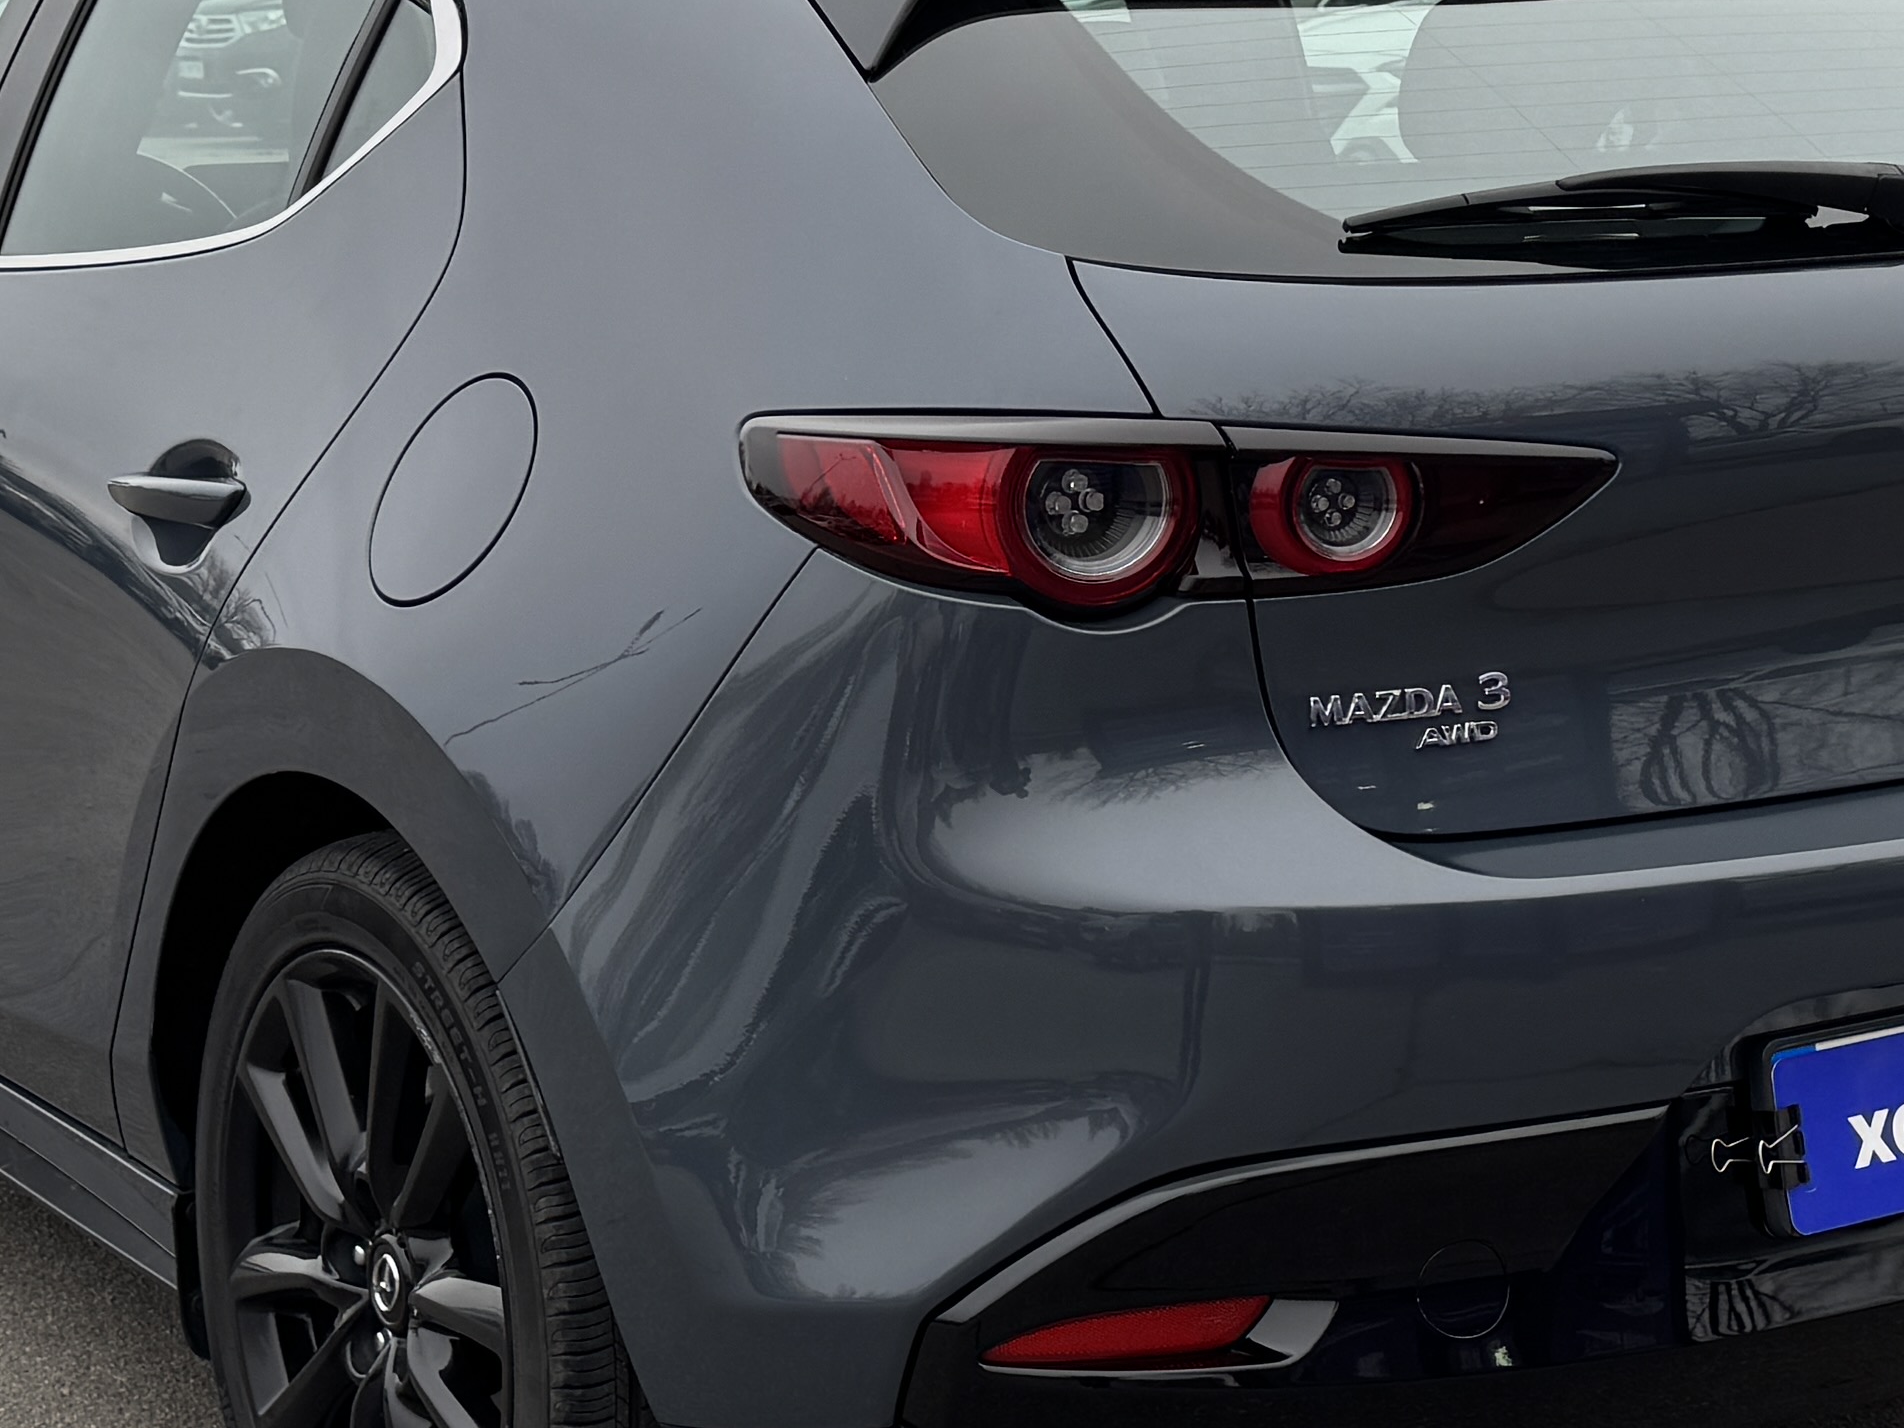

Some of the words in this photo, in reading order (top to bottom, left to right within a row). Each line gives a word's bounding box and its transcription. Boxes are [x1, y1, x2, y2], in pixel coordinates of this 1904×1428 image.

[1309, 683, 1463, 727] MAZDA
[1478, 671, 1511, 710] 3
[1415, 720, 1498, 749] AWD
